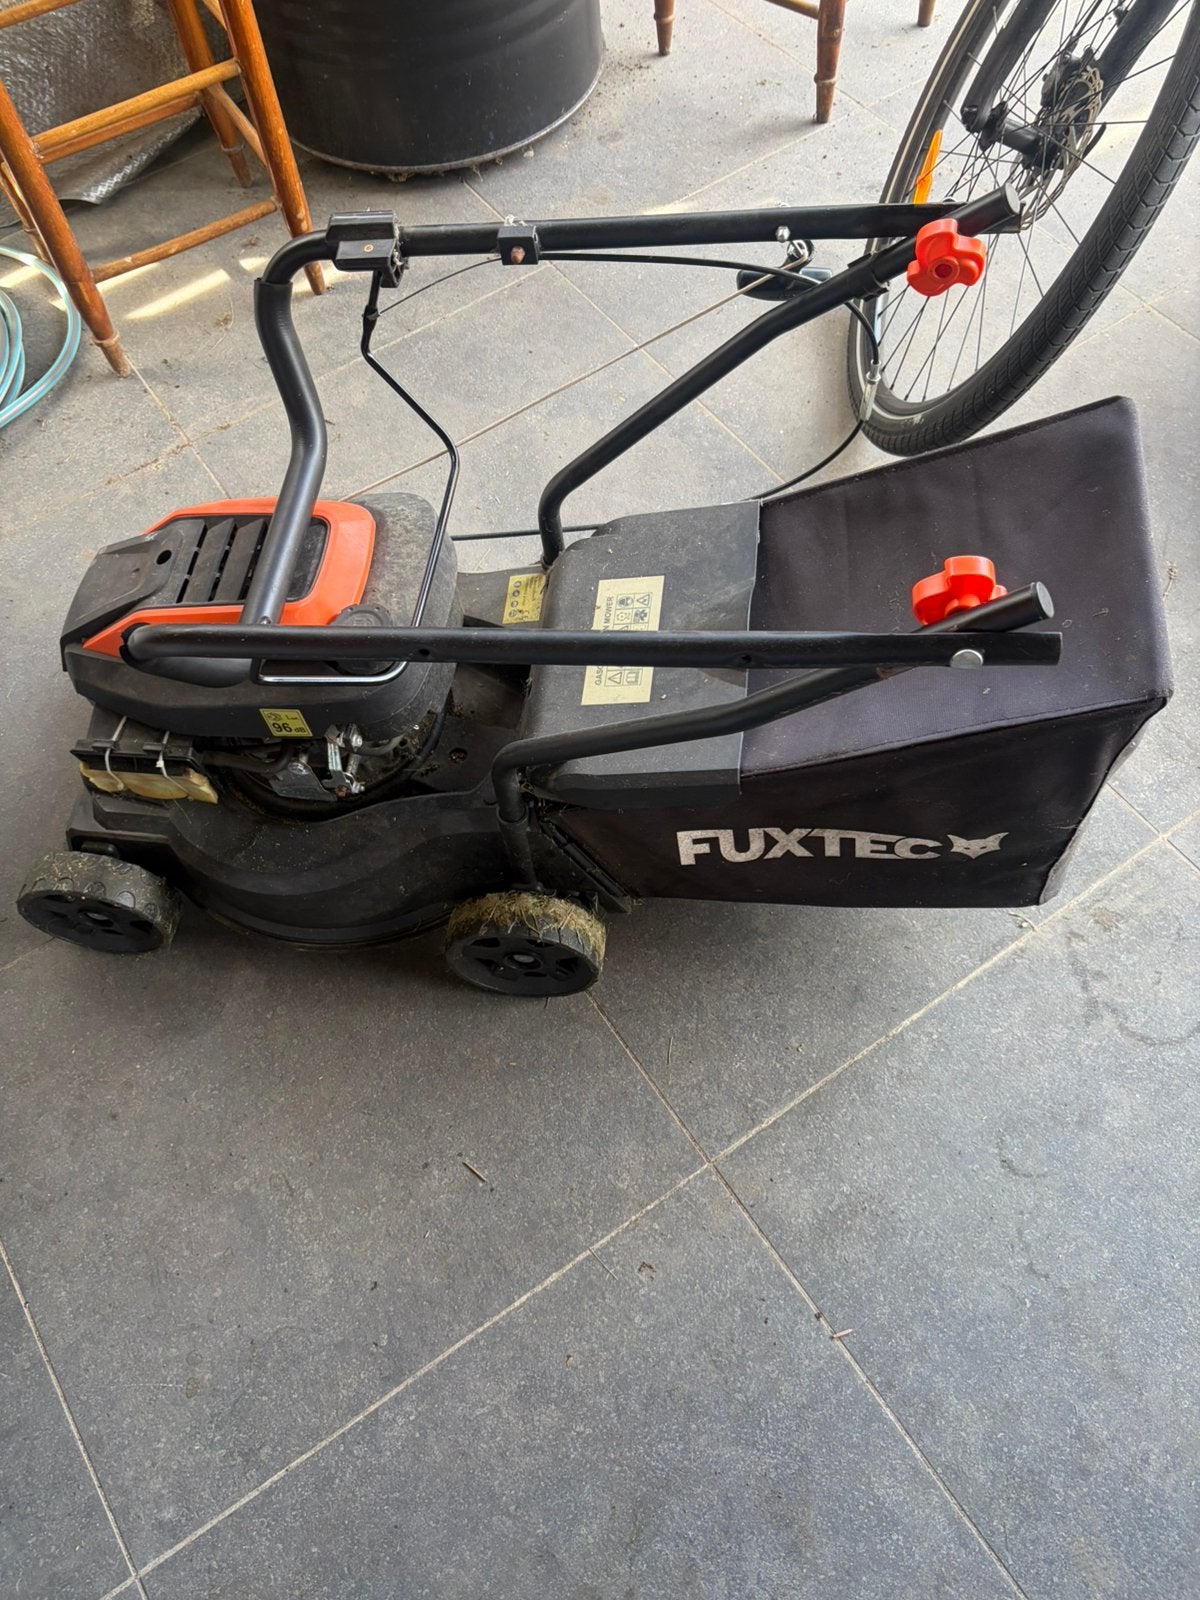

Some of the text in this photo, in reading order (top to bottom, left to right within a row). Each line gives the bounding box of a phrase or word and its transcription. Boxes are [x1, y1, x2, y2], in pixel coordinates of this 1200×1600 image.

[603, 596, 614, 624] MOWER
[272, 722, 292, 733] 96
[676, 827, 943, 866] FUXTEC
